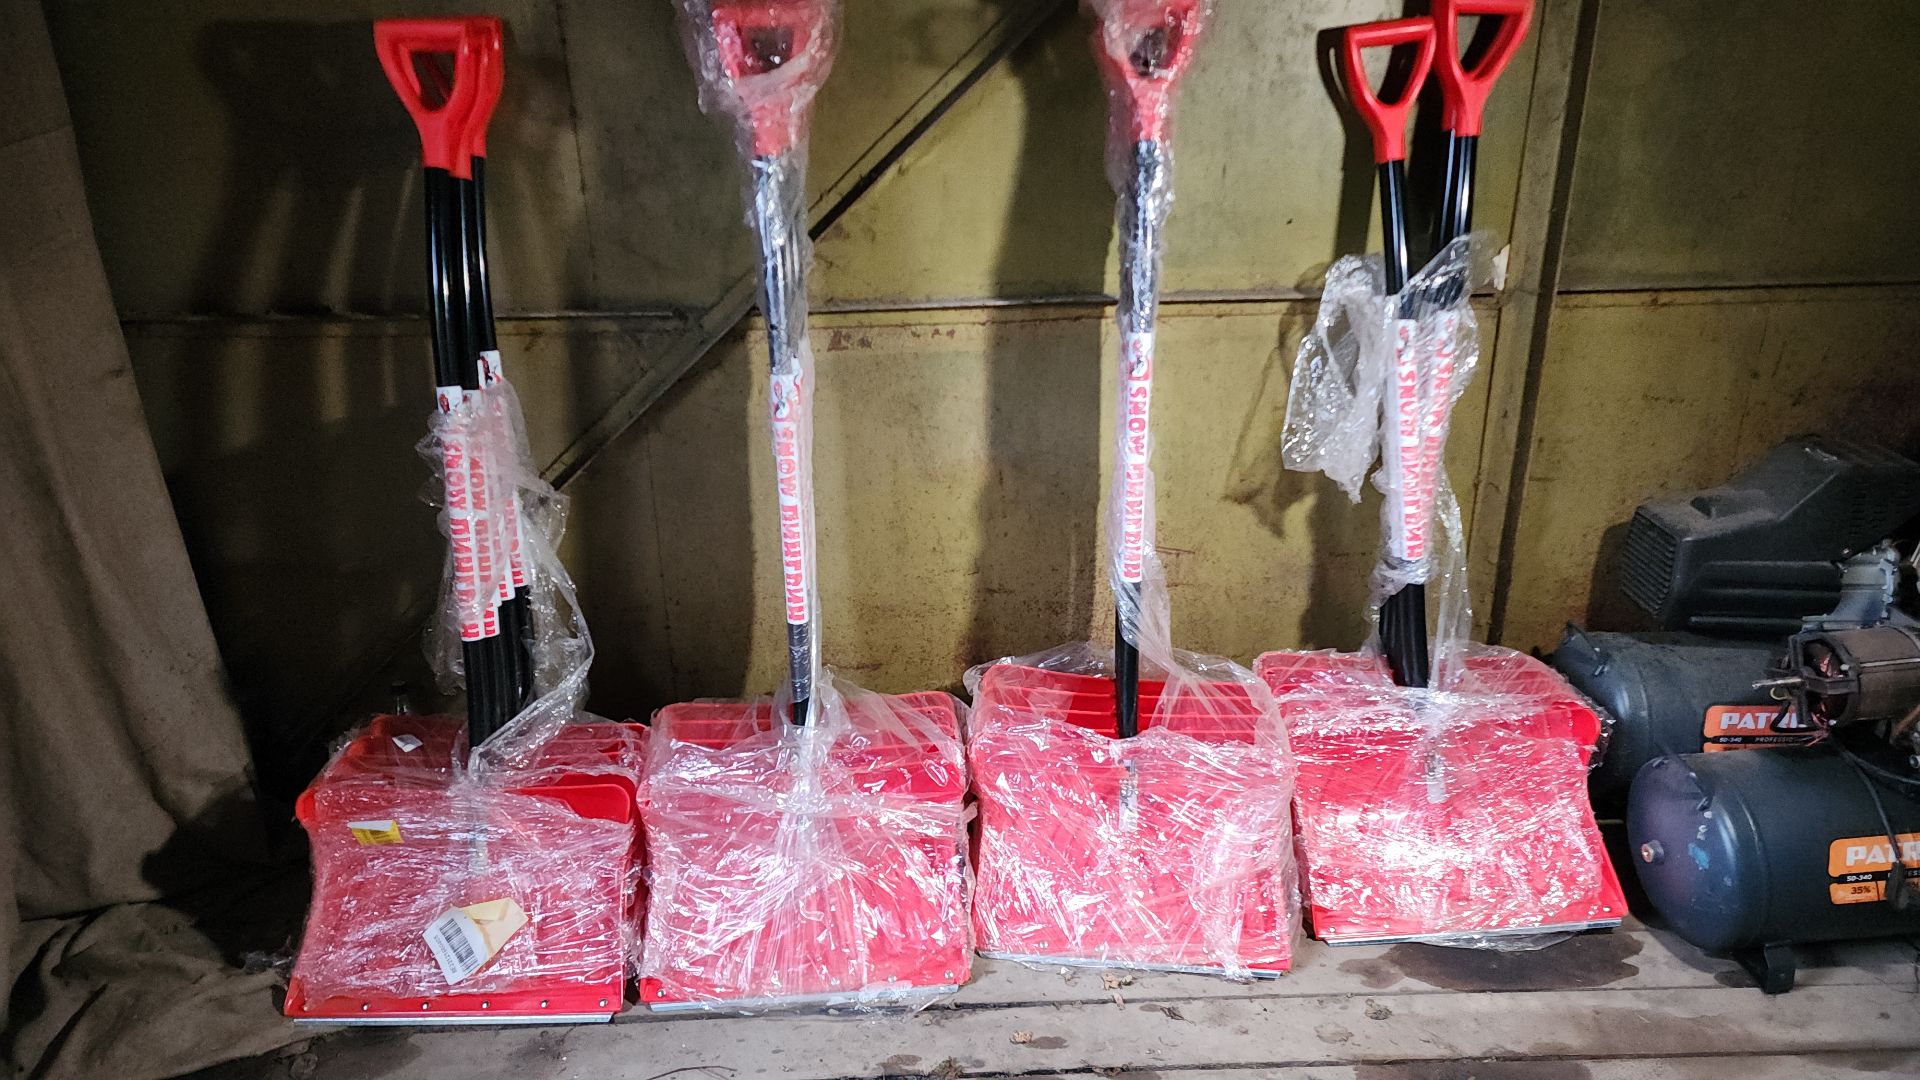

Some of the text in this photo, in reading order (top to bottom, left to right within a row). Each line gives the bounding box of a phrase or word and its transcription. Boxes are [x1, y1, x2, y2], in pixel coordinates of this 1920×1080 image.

[443, 440, 467, 511] SNOW
[1123, 385, 1147, 579] SNOW ПИНГВИН
[775, 425, 805, 621] SNOW ПИНГВИН
[1846, 874, 1873, 882] SD-340
[1850, 885, 1872, 895] 35%
